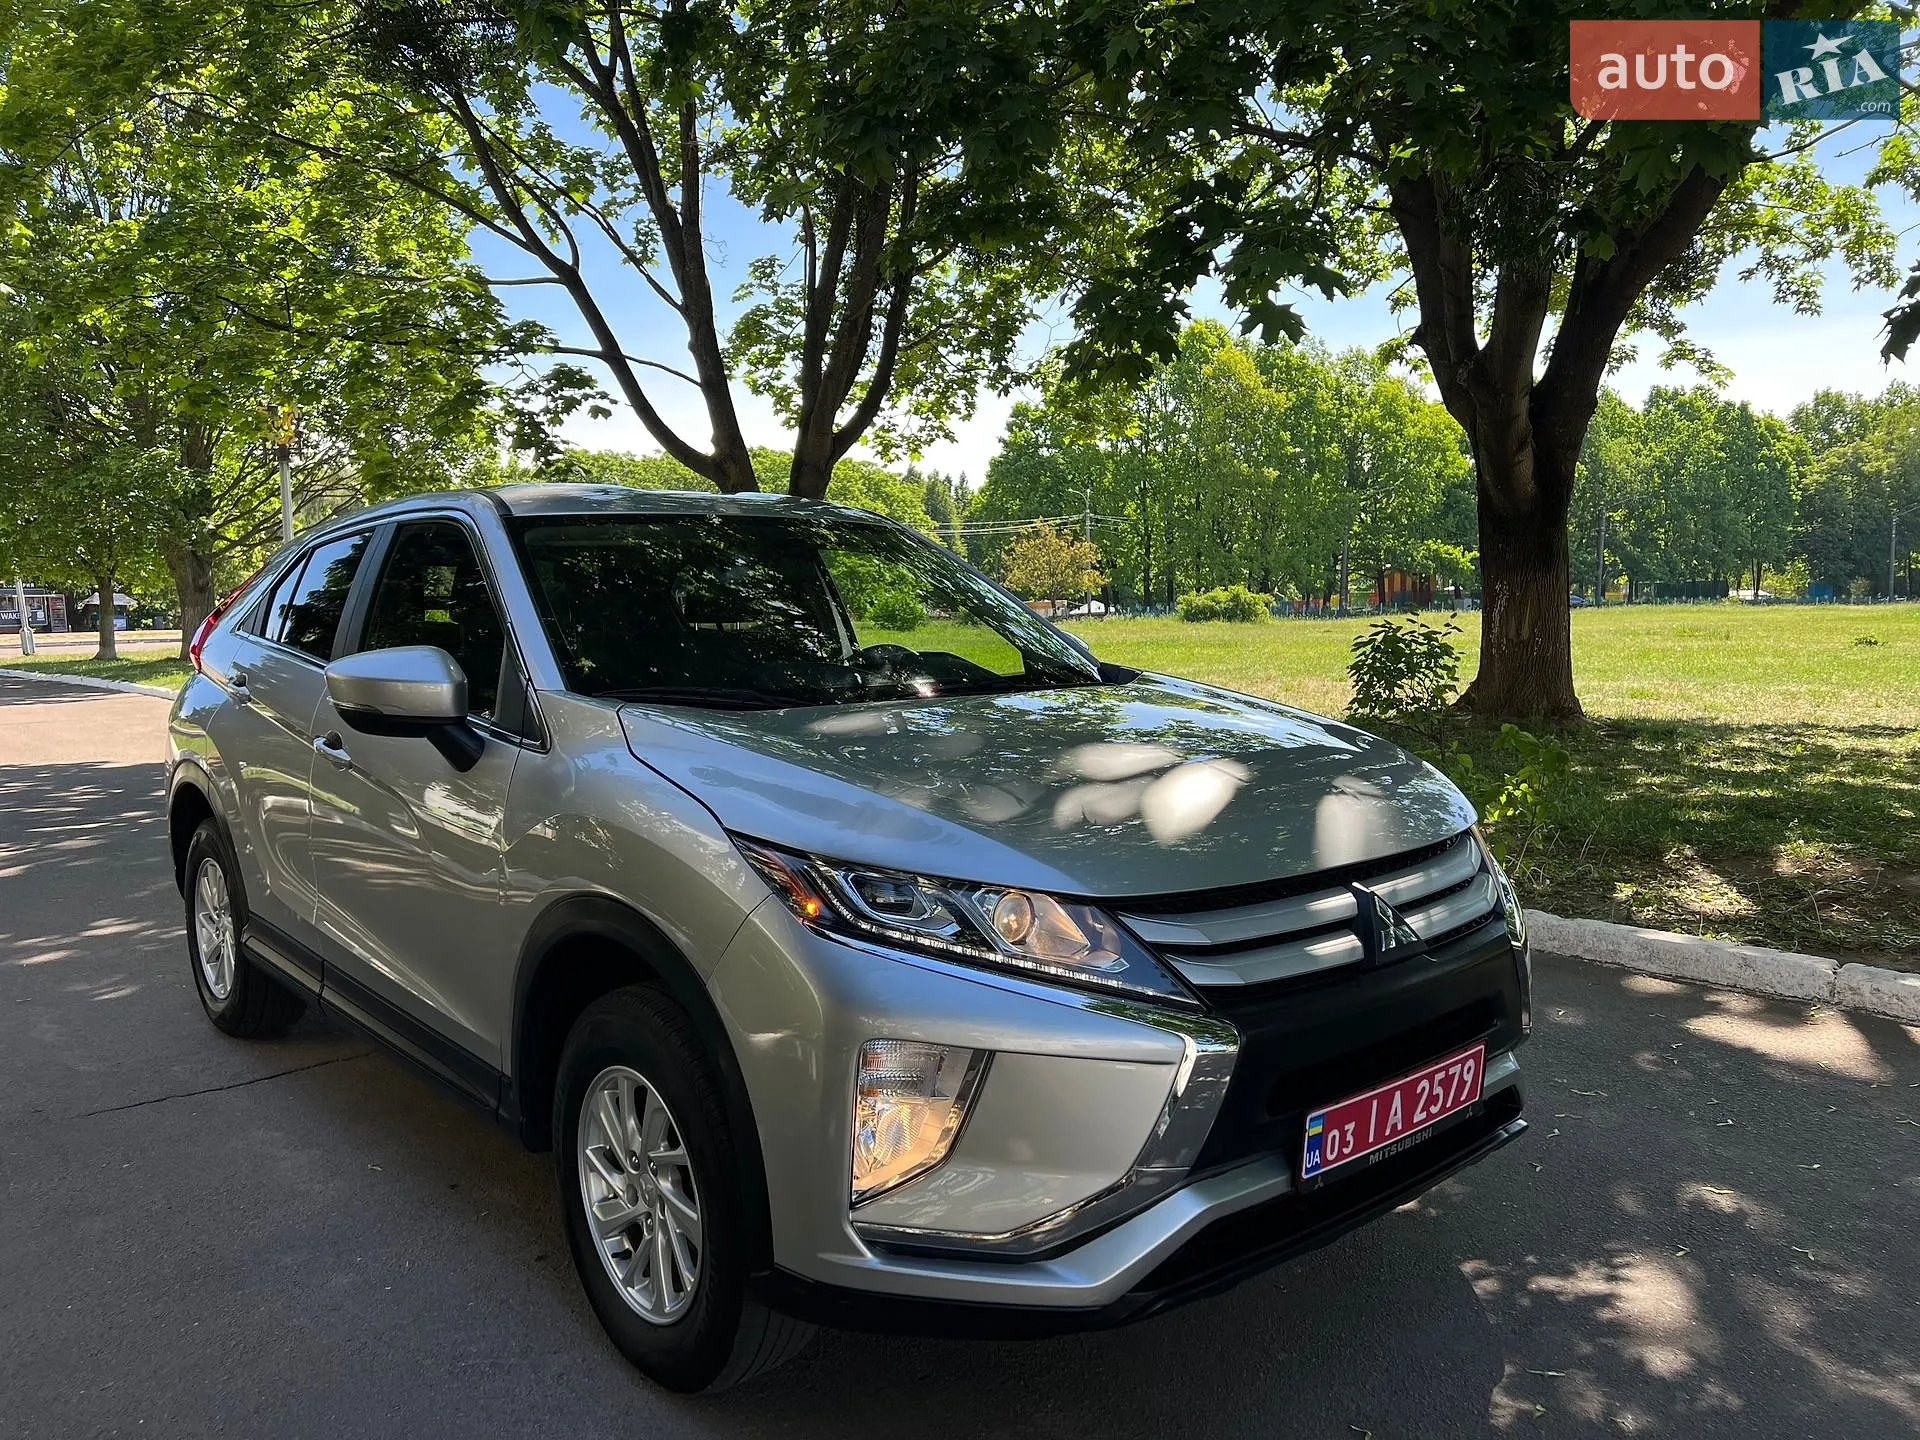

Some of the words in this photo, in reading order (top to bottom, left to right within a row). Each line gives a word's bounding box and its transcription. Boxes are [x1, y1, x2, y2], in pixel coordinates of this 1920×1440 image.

[1326, 1121, 1356, 1161] 03
[1368, 1089, 1403, 1143] IA
[1413, 1058, 1476, 1124] 2579
[1306, 1149, 1321, 1169] UA
[1368, 1126, 1433, 1166] MITSUBISHI
